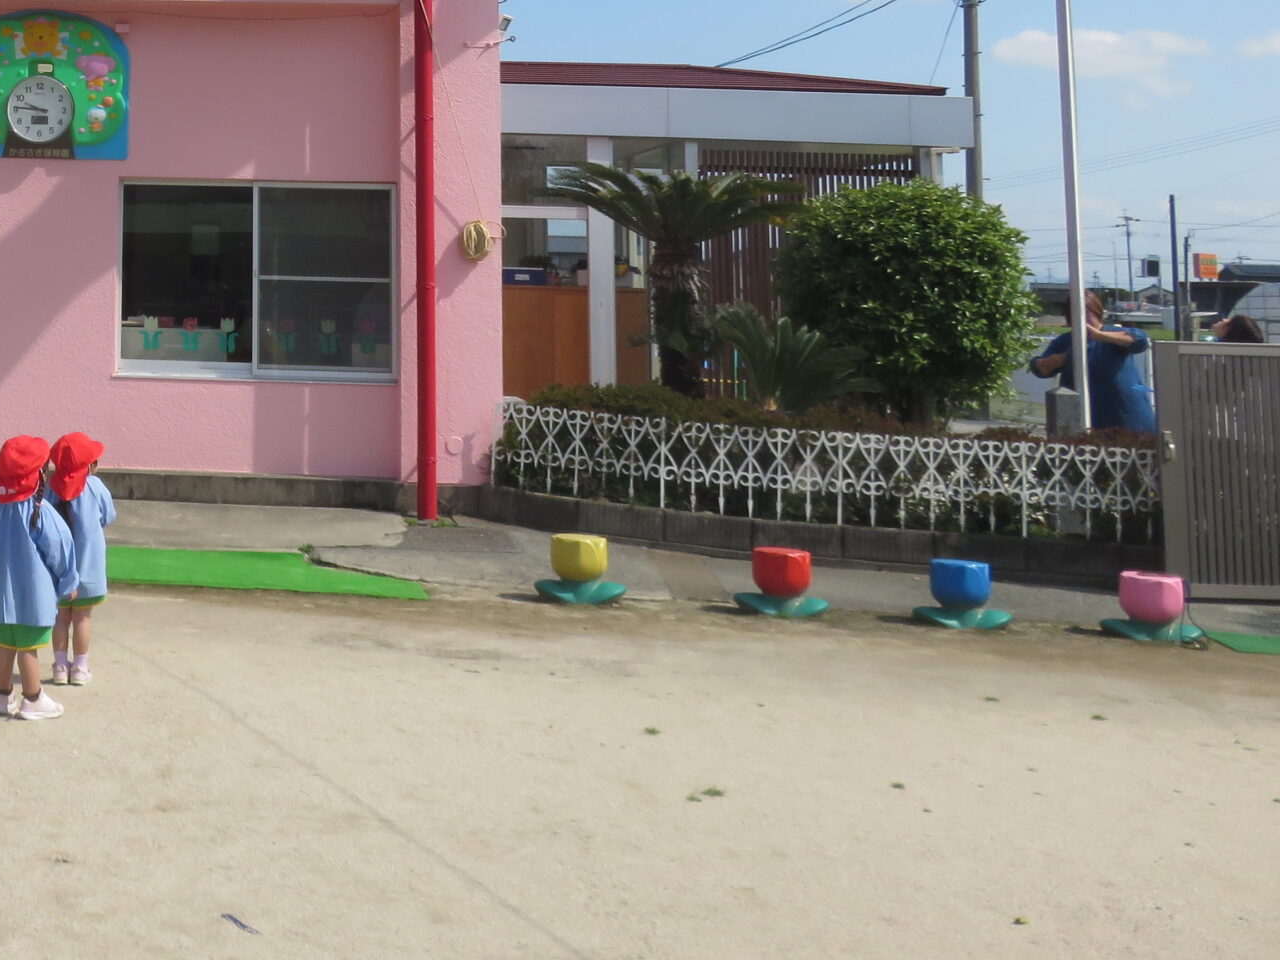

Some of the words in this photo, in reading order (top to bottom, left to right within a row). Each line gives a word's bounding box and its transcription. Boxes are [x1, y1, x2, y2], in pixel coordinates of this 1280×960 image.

[16, 94, 25, 102] 10
[61, 106, 67, 114] 3
[57, 118, 63, 126] 4
[25, 126, 31, 134] 7
